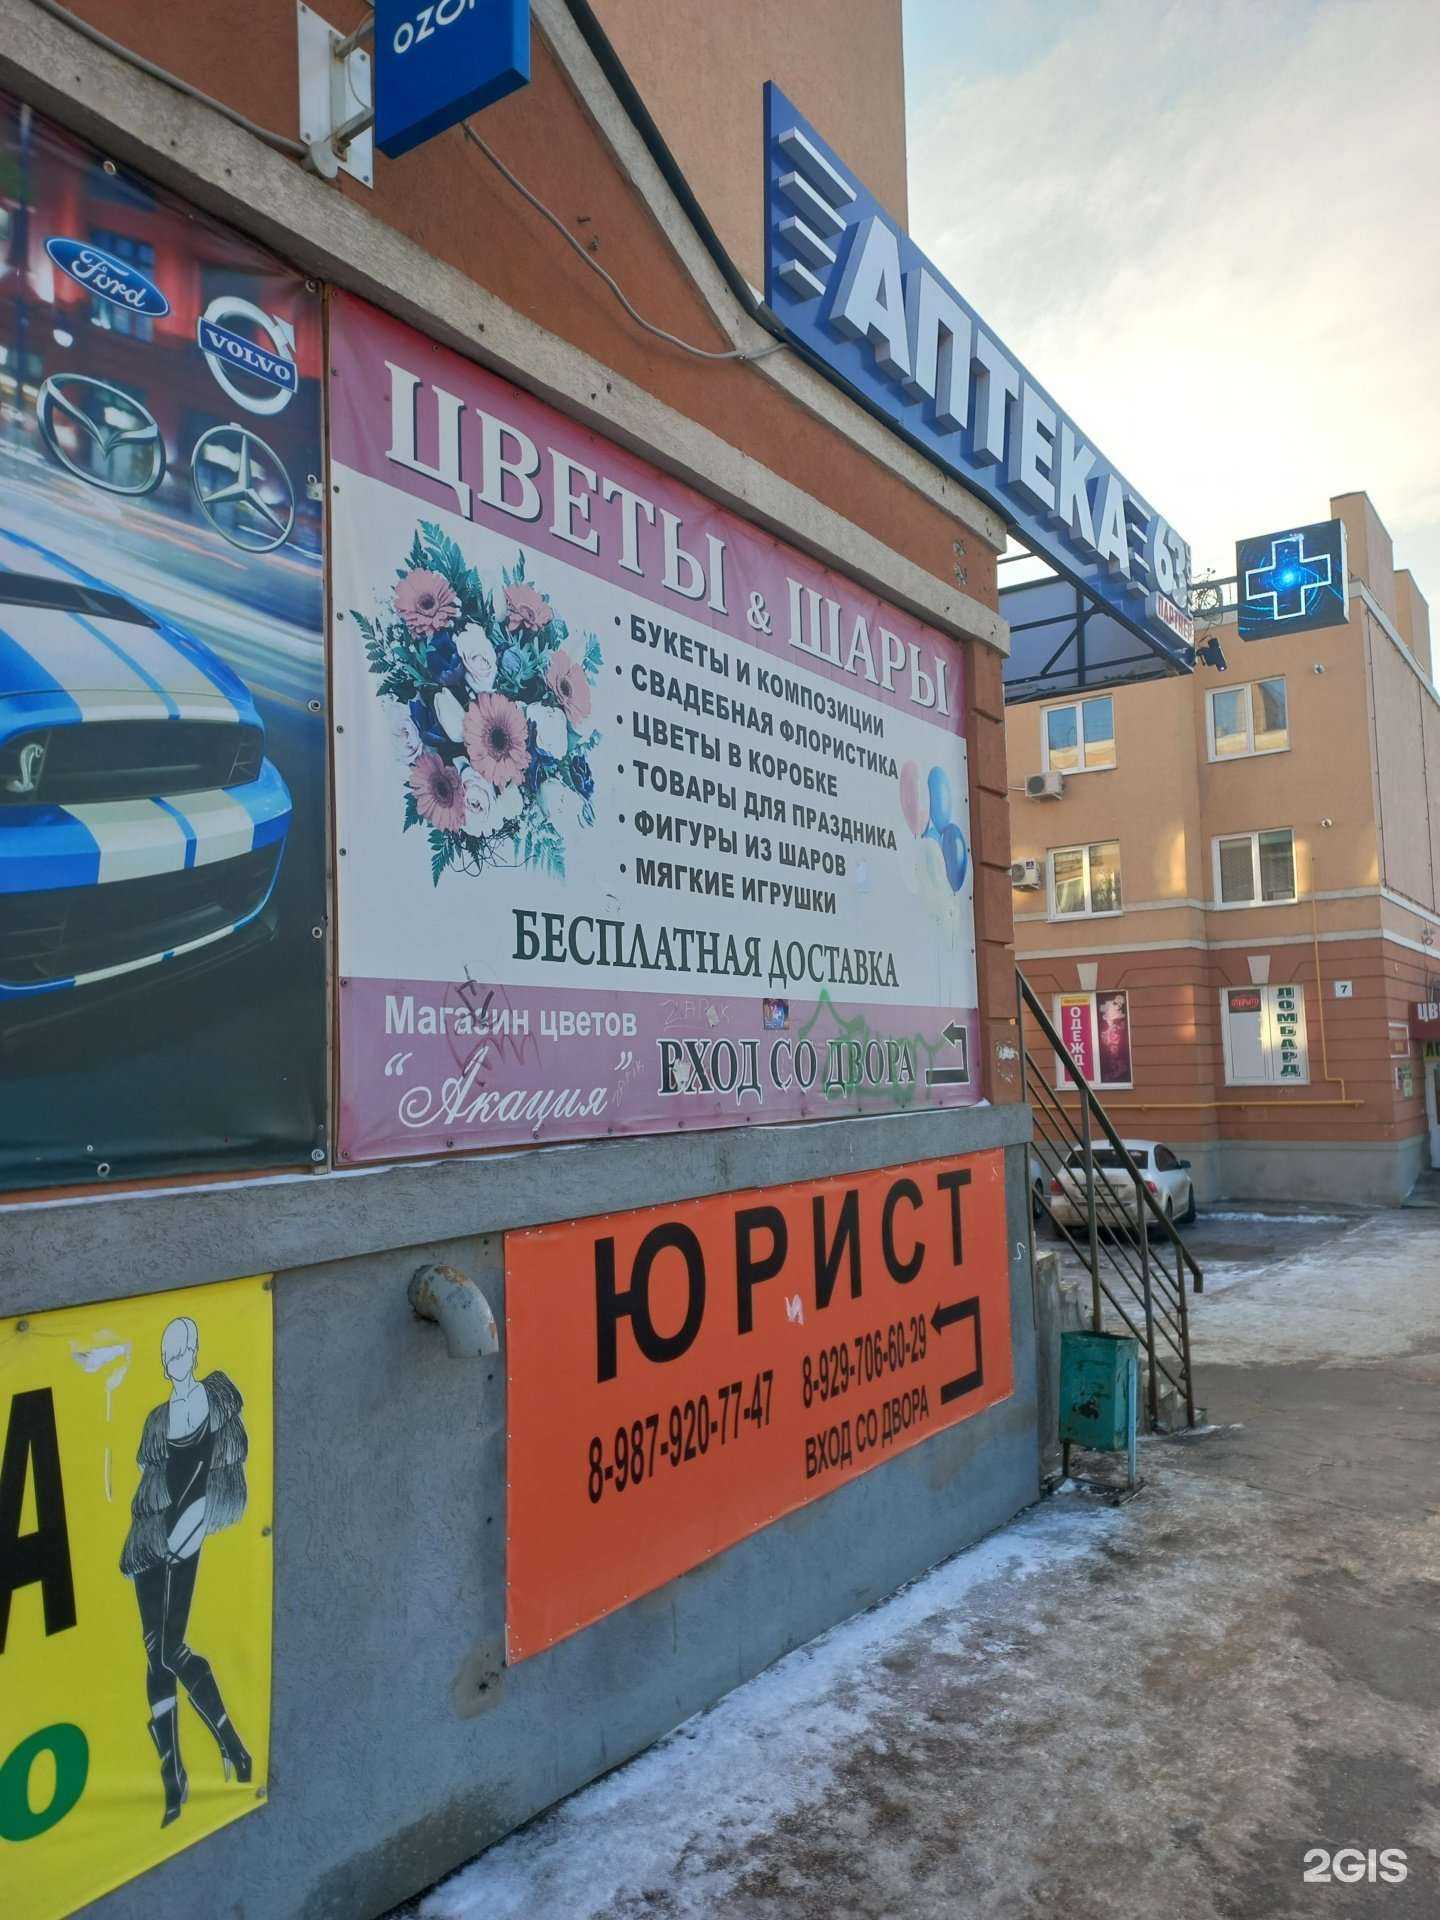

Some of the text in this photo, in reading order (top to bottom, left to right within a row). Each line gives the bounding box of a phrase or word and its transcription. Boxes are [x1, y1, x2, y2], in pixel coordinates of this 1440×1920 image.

[393, 0, 475, 54] OZO
[71, 250, 146, 308] Ford
[206, 329, 291, 381] VOLVO
[830, 216, 1187, 609] АПТЕКА 63
[385, 360, 950, 717] ЦВЕТЫ & ШАРЫ
[630, 614, 884, 738] БУКЕТЫ И КОМПОЗИЦИИ
[631, 664, 899, 779] СВАДЕБНАЯ ФЛОРИСТИКА
[633, 711, 838, 797] ЦВЕТЫ В КОРОБКЕ
[633, 760, 897, 850] ТОВАРЫ ДЛЯ ПРАЗДНИКА
[634, 810, 846, 876] ФИГУРЫ ИЗ ШАРОВ
[636, 857, 836, 914] МЯГКИЕ ИГРУШКИ
[512, 908, 899, 989] БЕСПЛАТНАЯ ДОСТАВКА
[1339, 985, 1348, 994] 7
[384, 995, 529, 1036] Магазин
[540, 1010, 637, 1041] цветов
[1069, 1006, 1086, 1078] ОДЕЖД
[1277, 987, 1301, 1078] ЛОМБАРД
[657, 1039, 763, 1105] ВХОД
[769, 1039, 817, 1094] СО
[825, 1039, 916, 1099] ДВОРА
[594, 1169, 972, 1384] ЮРИСТ
[802, 1313, 926, 1408] 8-929-706-60-29
[588, 1370, 773, 1503] 8-987-920-77-47
[805, 1385, 929, 1479] ВХОД СО ДВОРА
